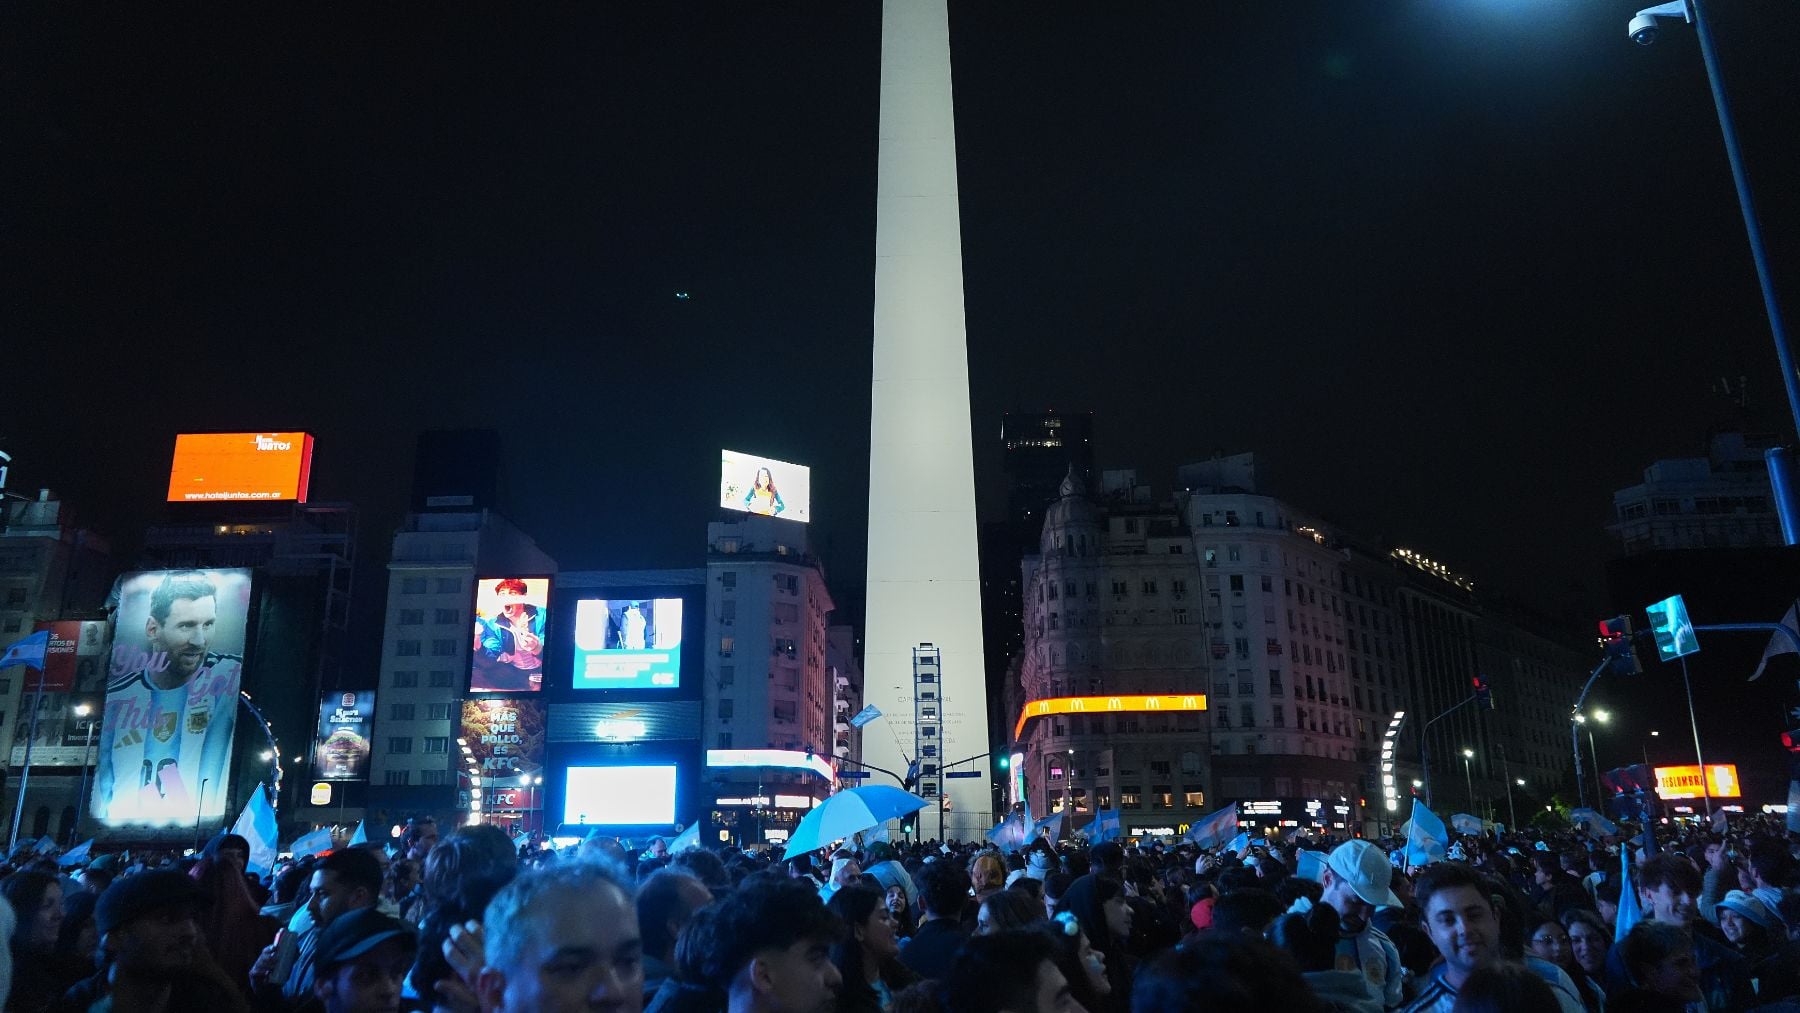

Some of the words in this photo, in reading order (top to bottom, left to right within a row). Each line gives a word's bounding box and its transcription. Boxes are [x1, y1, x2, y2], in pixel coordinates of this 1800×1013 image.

[184, 491, 281, 500] www.hoteljuntos.com.ar
[110, 645, 172, 677] You
[187, 663, 241, 707] Got
[104, 697, 170, 733] This
[490, 723, 515, 734] QUE
[481, 735, 523, 745] POLLO,
[494, 746, 508, 755] ES
[484, 757, 518, 770] KFC
[486, 794, 515, 805] KFC
